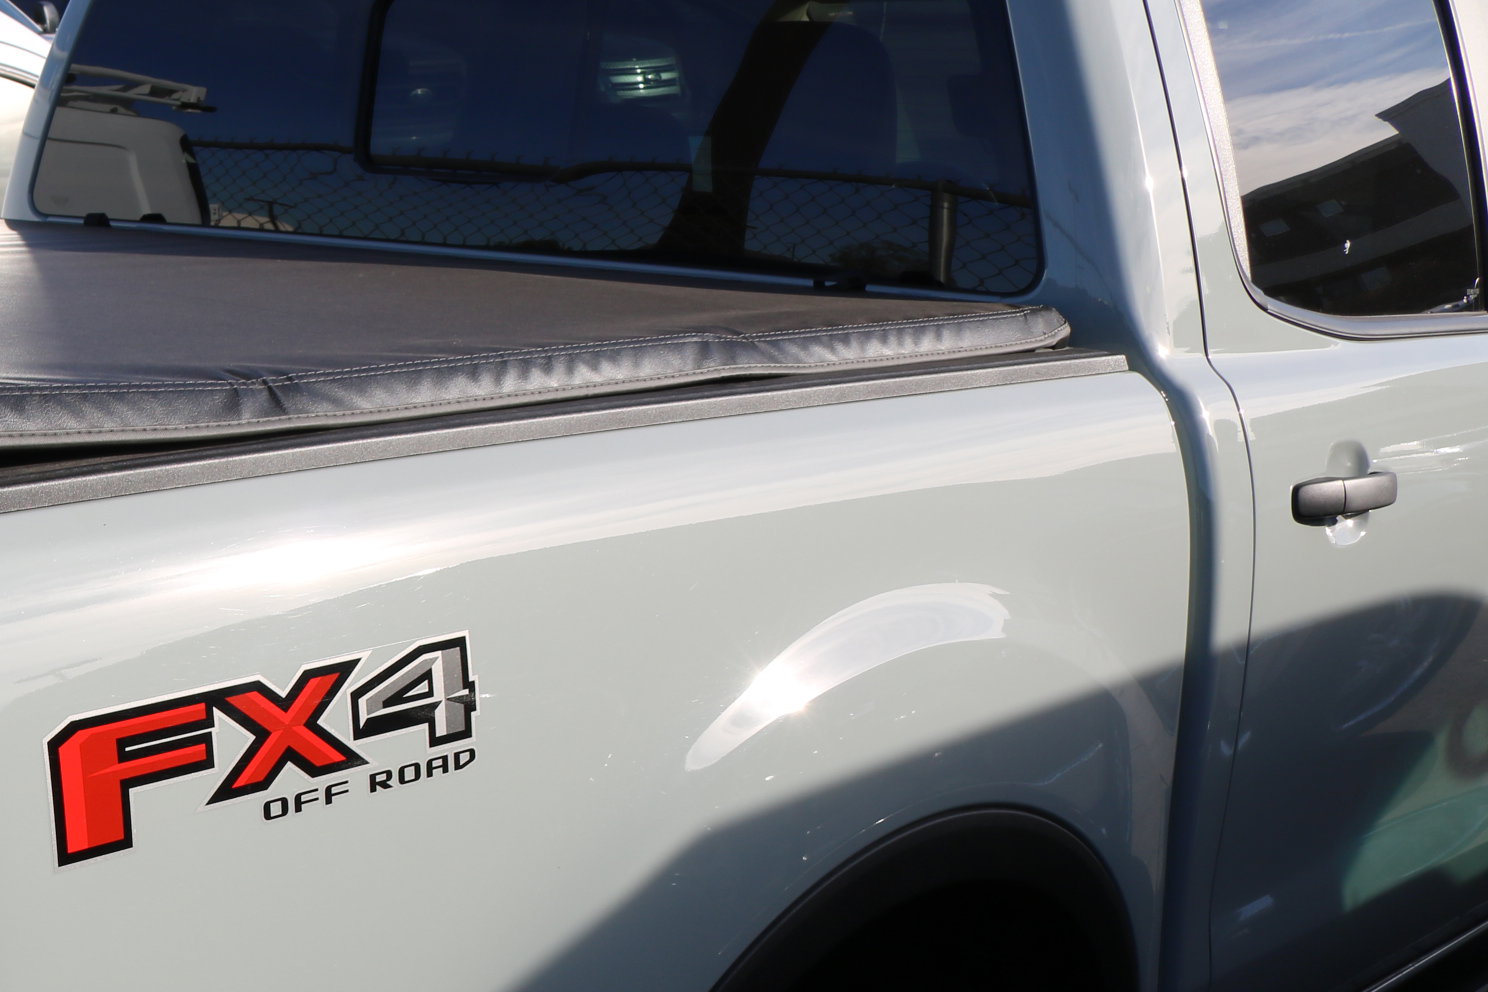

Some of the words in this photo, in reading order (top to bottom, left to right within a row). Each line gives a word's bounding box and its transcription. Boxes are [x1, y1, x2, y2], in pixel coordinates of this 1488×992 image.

[47, 634, 478, 868] FX4
[262, 780, 350, 822] OFF
[368, 747, 477, 794] ROAD
